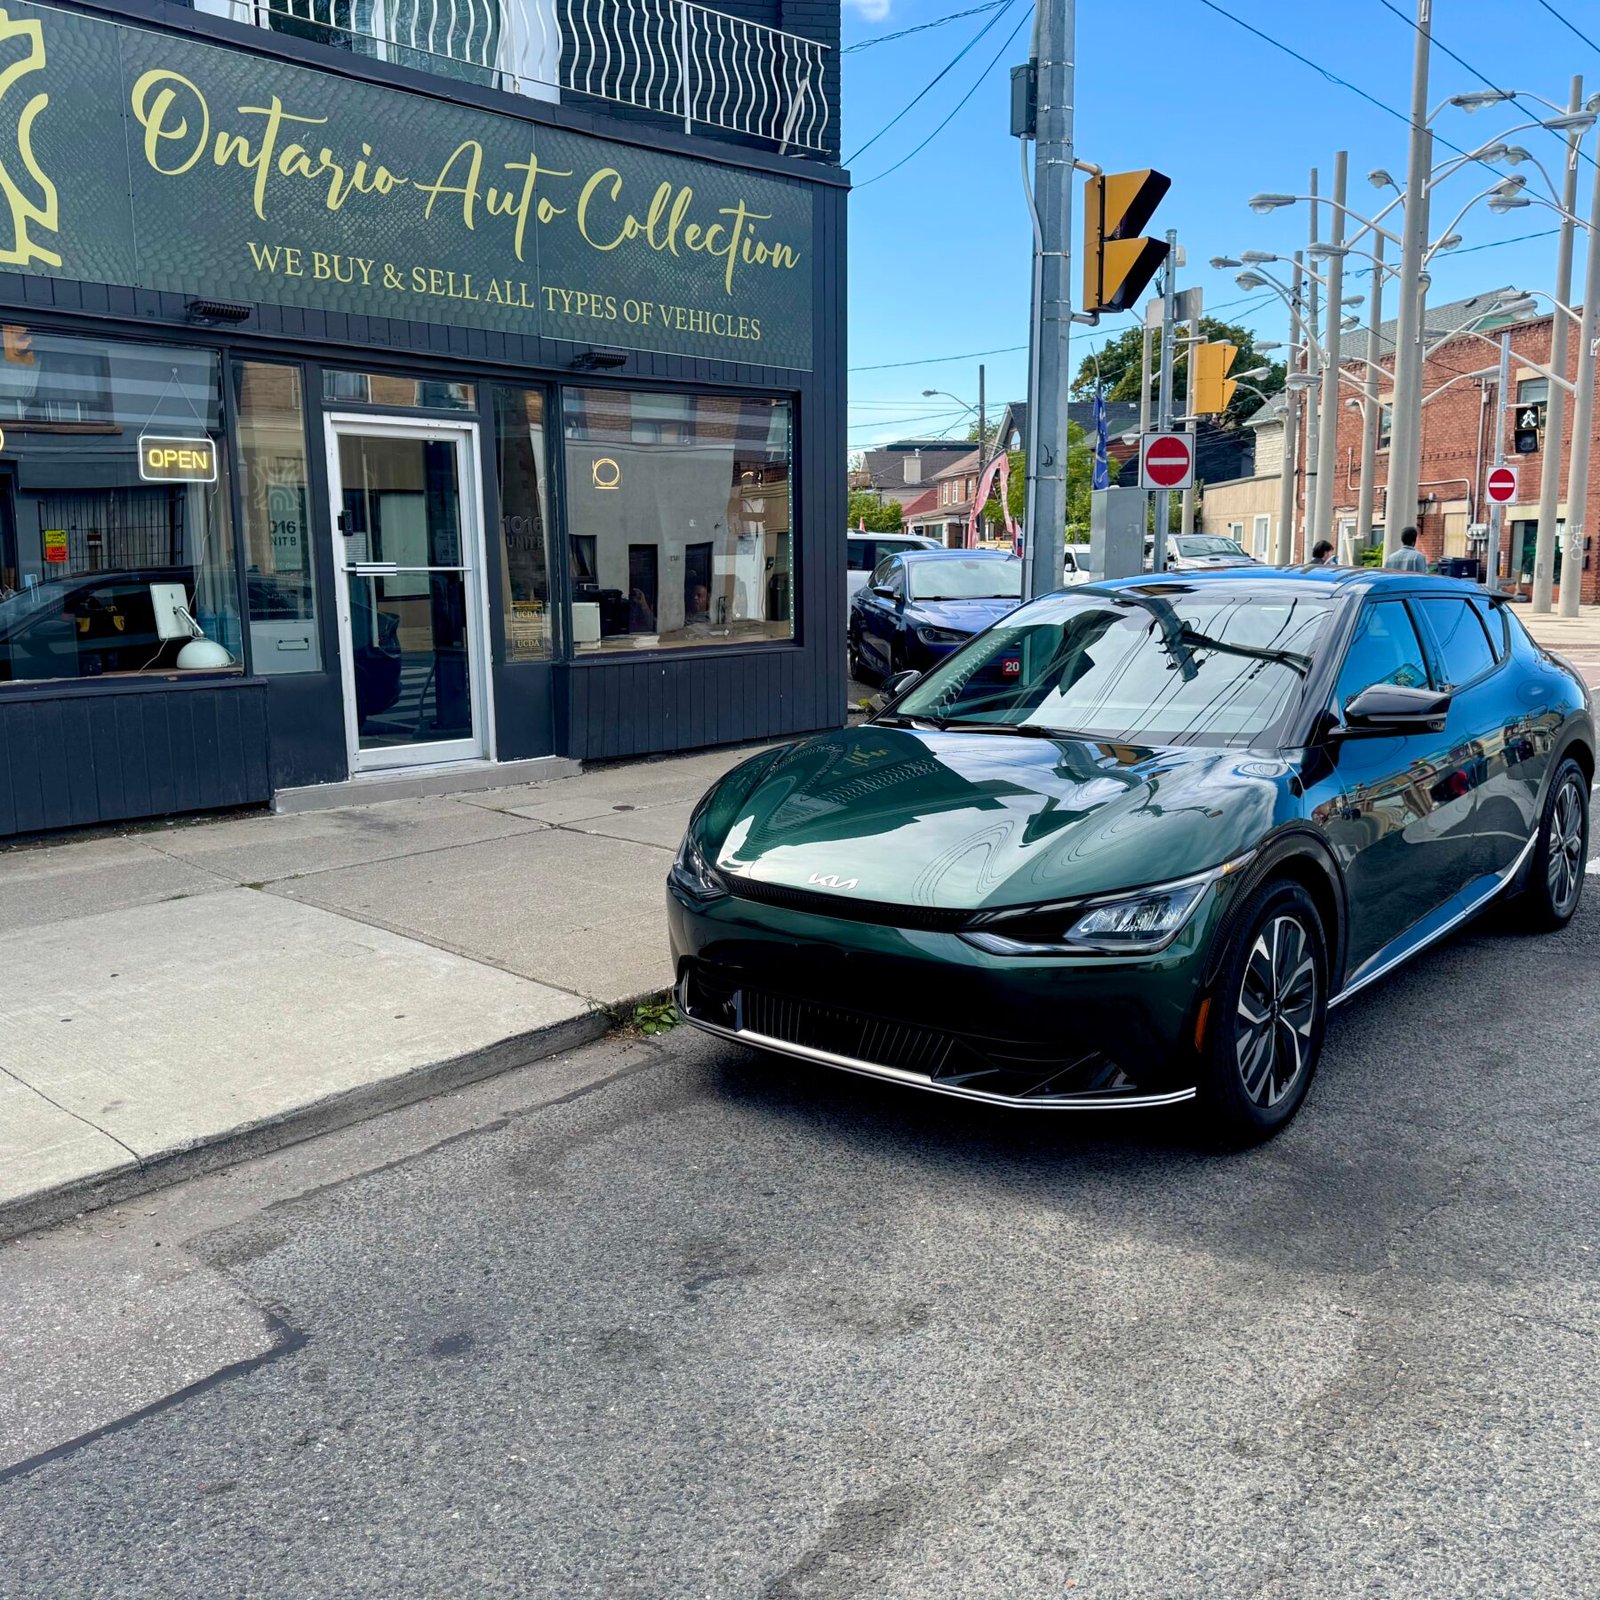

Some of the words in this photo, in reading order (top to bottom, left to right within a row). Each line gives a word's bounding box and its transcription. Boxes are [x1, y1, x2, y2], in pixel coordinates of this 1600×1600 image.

[131, 69, 408, 221] Ontario
[413, 140, 573, 262] Auto
[577, 167, 801, 296] Collection
[247, 241, 304, 277] WE
[312, 251, 376, 286] BUY
[383, 263, 405, 290] &
[411, 266, 479, 300] SELL
[485, 278, 535, 309] ALL
[542, 285, 617, 320] TYPES
[623, 298, 654, 326] OF
[658, 304, 762, 342] VEHICLES
[148, 448, 209, 470] OPEN
[517, 639, 540, 648] UCDA
